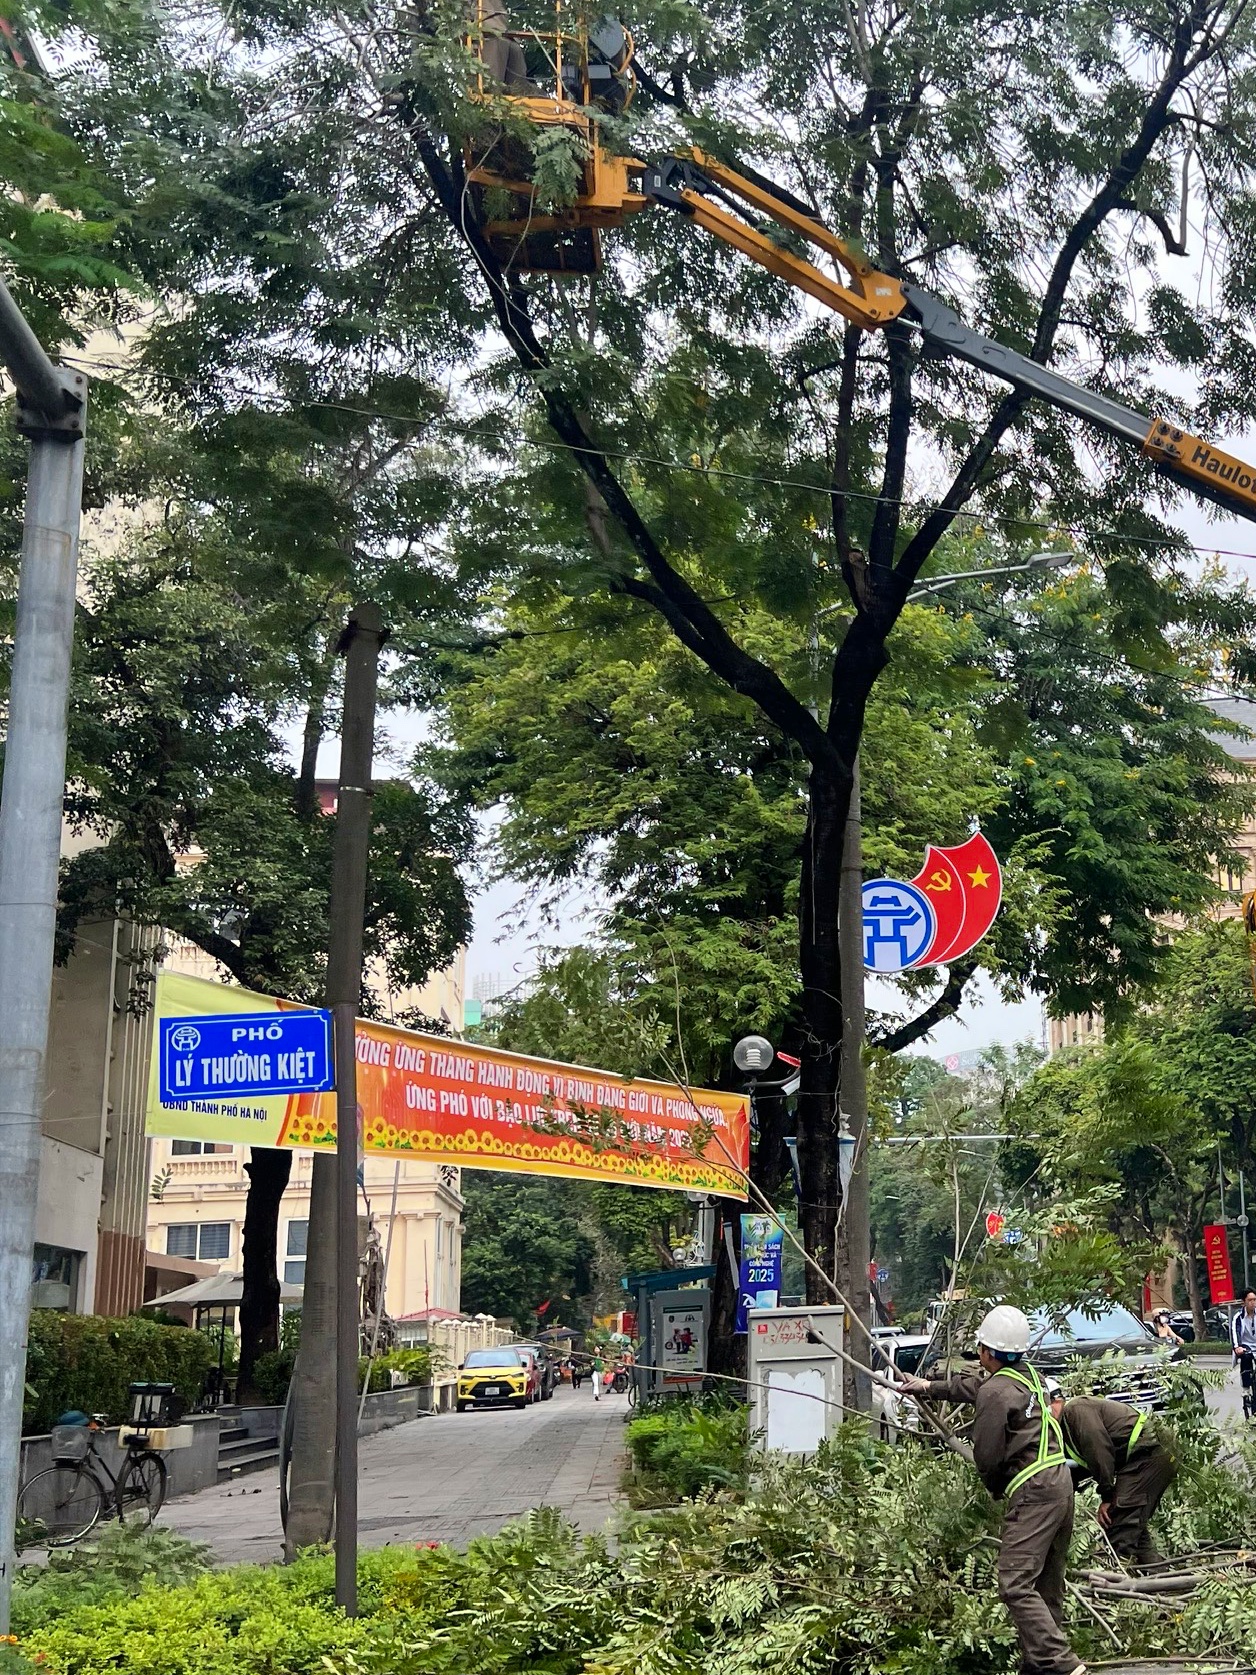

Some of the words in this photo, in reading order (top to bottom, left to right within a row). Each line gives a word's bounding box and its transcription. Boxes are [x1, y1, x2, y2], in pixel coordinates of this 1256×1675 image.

[232, 1019, 283, 1042] PHỐ
[175, 1053, 195, 1087] LÝ
[201, 1049, 271, 1085] THƯỜNG
[277, 1047, 316, 1084] KIỆT
[394, 1040, 426, 1074] ỨNG
[429, 1051, 475, 1083] THÁNG
[477, 1059, 514, 1089] HÀNH
[516, 1067, 551, 1098] ĐỘNG
[567, 1076, 594, 1103] BÌNH
[596, 1080, 626, 1109] ĐẲNG
[628, 1088, 649, 1113] GIỚI
[651, 1093, 664, 1118] VÀ
[666, 1096, 699, 1122] PHÒNG
[221, 1103, 238, 1117] PHỐ
[240, 1106, 251, 1118] HÀ
[253, 1107, 267, 1123] NỘI
[405, 1080, 437, 1112] ỨNG
[440, 1089, 467, 1117] PHÓ
[471, 1092, 494, 1121] VỚI
[748, 1269, 774, 1283] 2025
